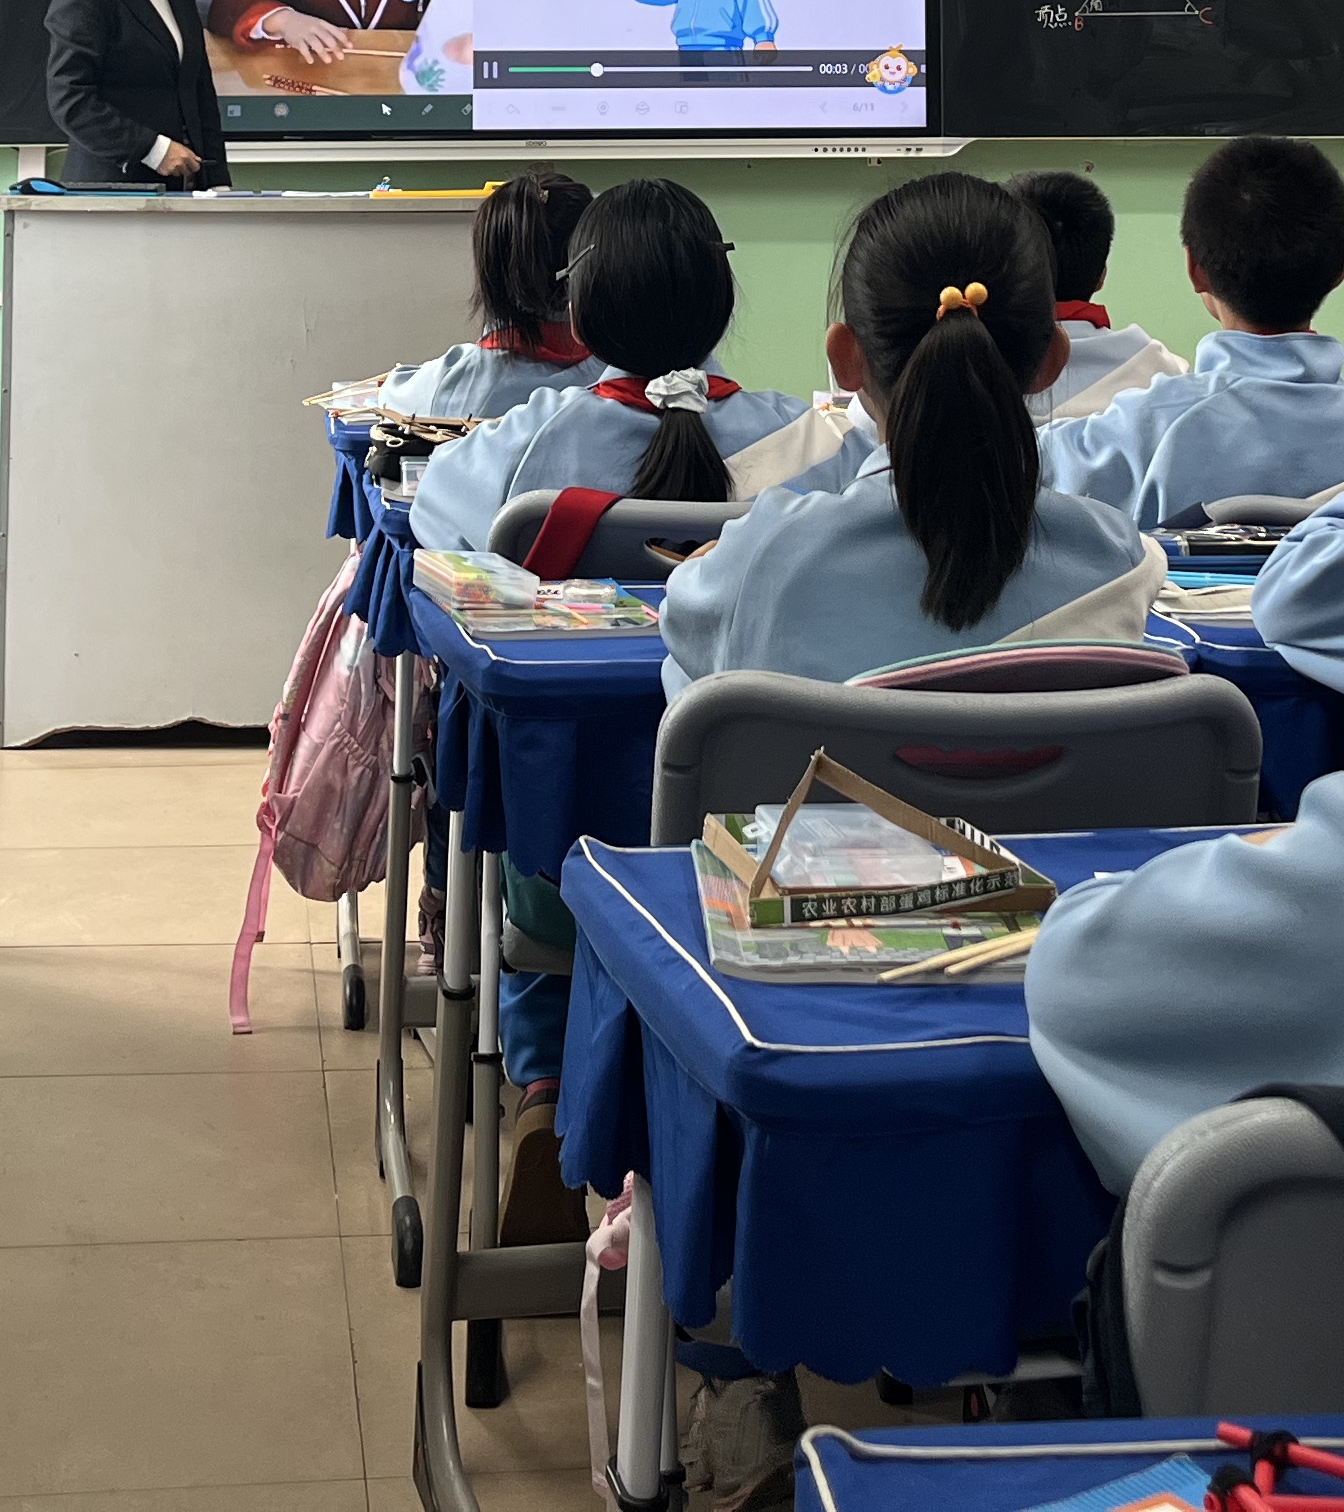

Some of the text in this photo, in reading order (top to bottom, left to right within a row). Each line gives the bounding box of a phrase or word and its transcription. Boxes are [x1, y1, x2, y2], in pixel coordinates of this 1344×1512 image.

[1034, 4, 1072, 29] 顶点
[1198, 6, 1214, 25] C
[1074, 16, 1085, 32] B
[818, 63, 848, 75] 00:03
[852, 102, 875, 113] 6/11
